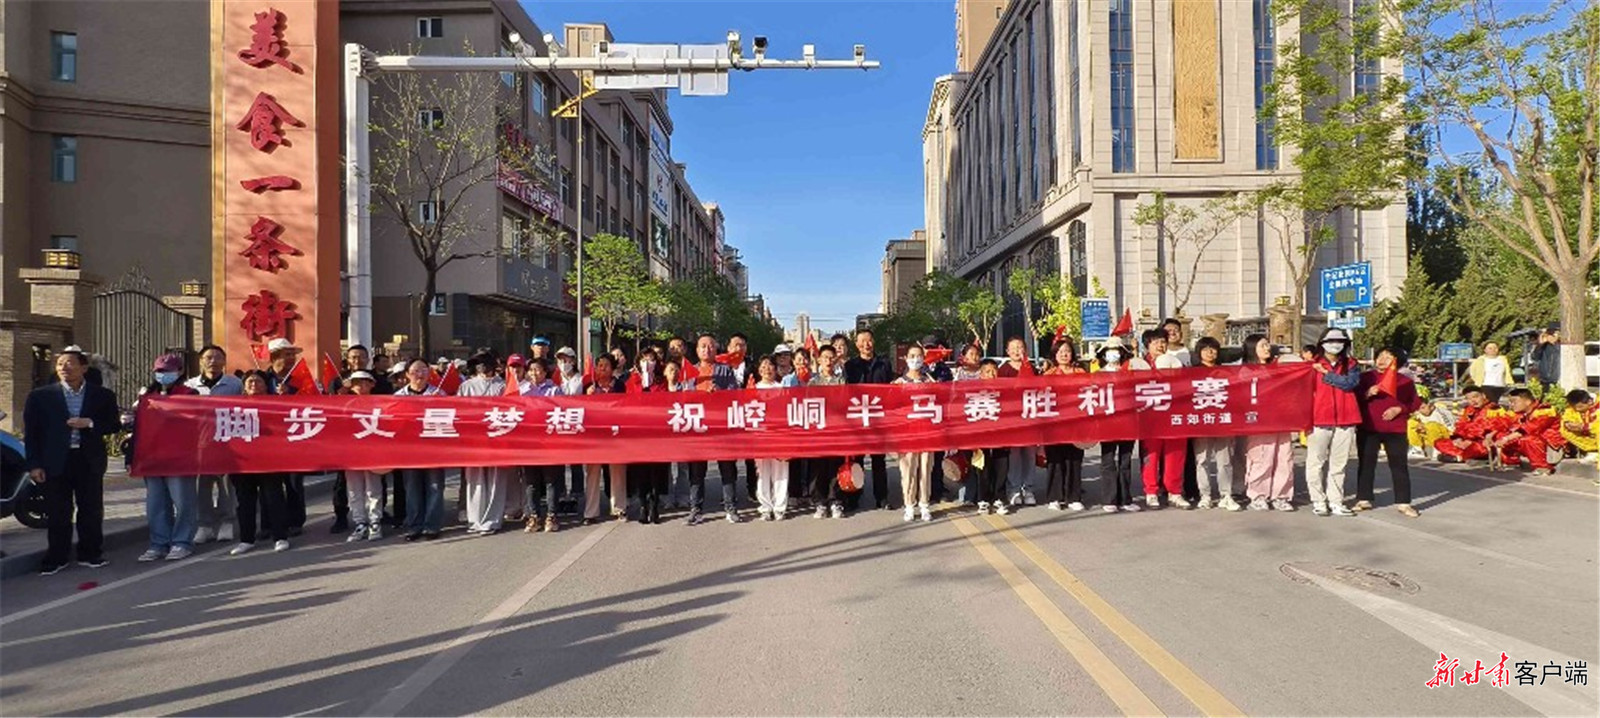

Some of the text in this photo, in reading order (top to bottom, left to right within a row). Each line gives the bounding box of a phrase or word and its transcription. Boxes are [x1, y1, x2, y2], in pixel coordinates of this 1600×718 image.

[237, 7, 306, 342] 美食一条街
[1170, 411, 1259, 426] 西郊街道 宣
